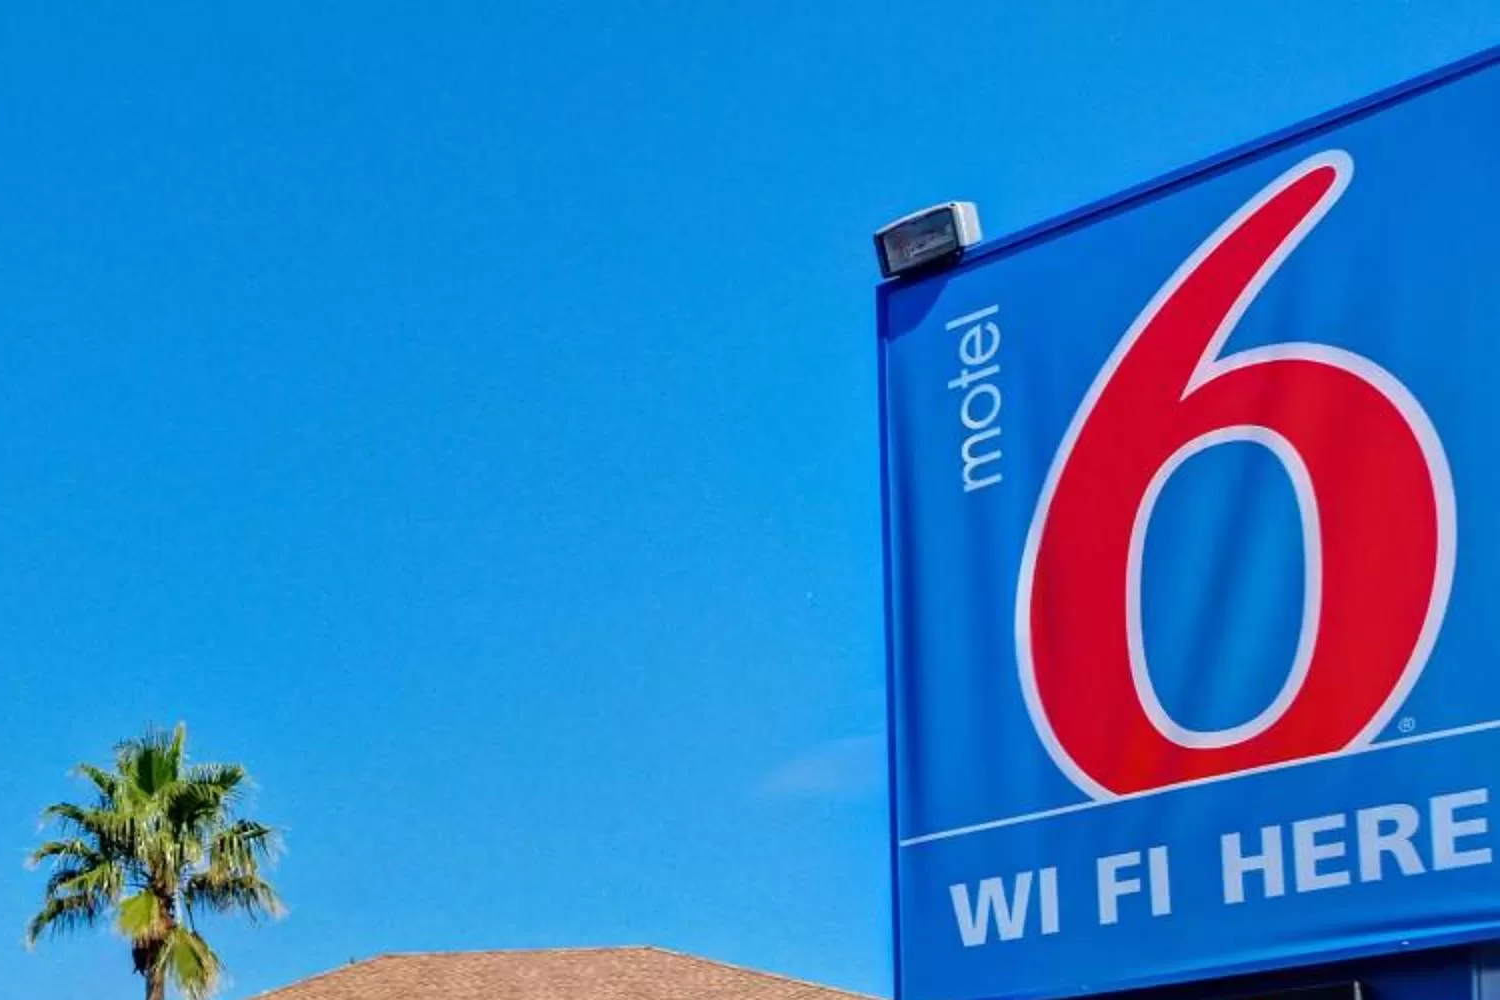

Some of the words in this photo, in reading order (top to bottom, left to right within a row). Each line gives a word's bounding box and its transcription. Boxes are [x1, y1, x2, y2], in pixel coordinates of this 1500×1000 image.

[945, 304, 1003, 493] motel
[1015, 149, 1457, 800] 6
[949, 866, 1060, 947] WI
[1097, 845, 1172, 925] FI
[1221, 788, 1493, 905] HERE
